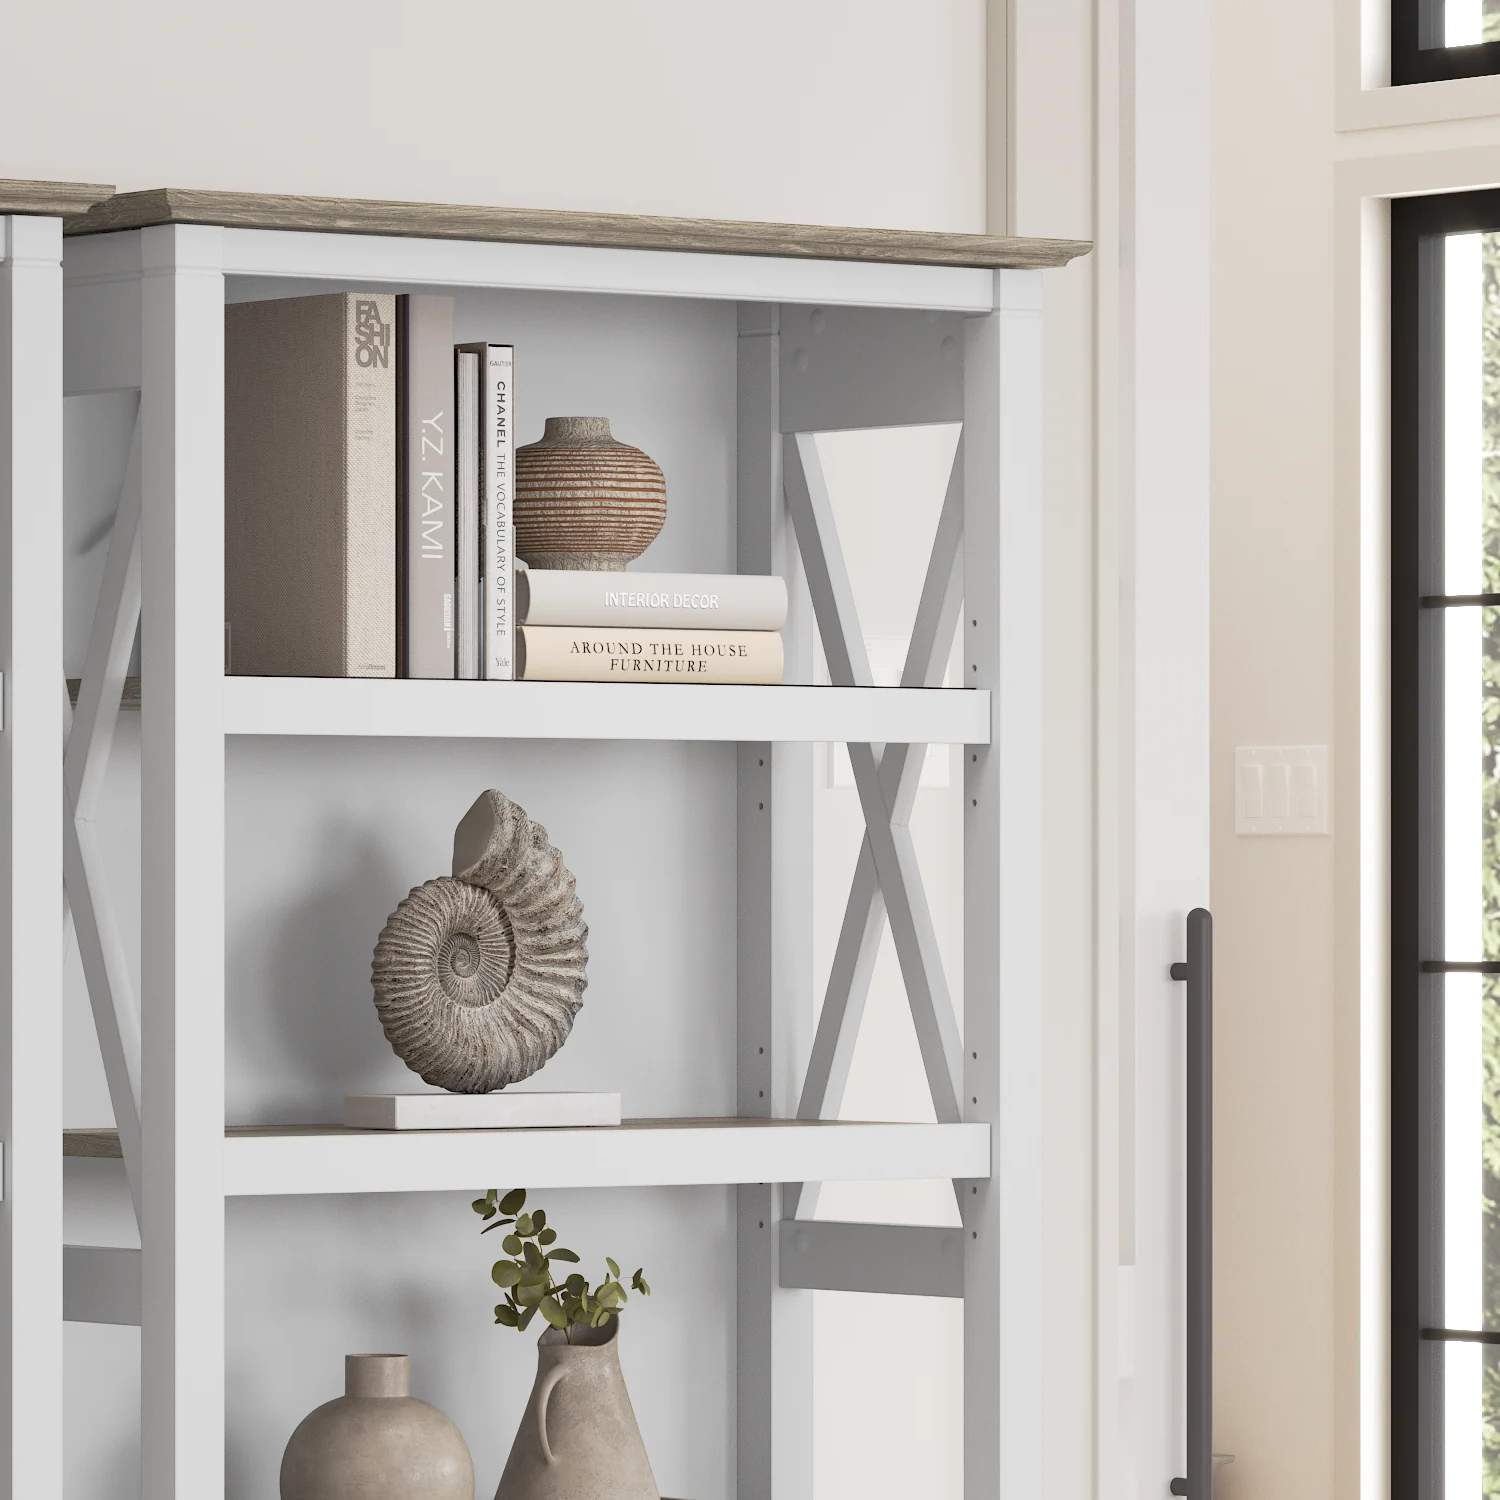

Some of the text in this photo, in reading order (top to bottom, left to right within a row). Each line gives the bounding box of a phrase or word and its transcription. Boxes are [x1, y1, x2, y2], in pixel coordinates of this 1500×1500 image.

[421, 411, 444, 559] Y.Z. KAMI
[496, 381, 506, 636] CHANEL THE VOCABULARY OF STYLE
[604, 591, 719, 610] INTERIOR DECOR
[570, 641, 748, 657] AROUND THE HOUSE
[495, 657, 510, 667] Yale
[609, 658, 707, 673] FURNITURE
